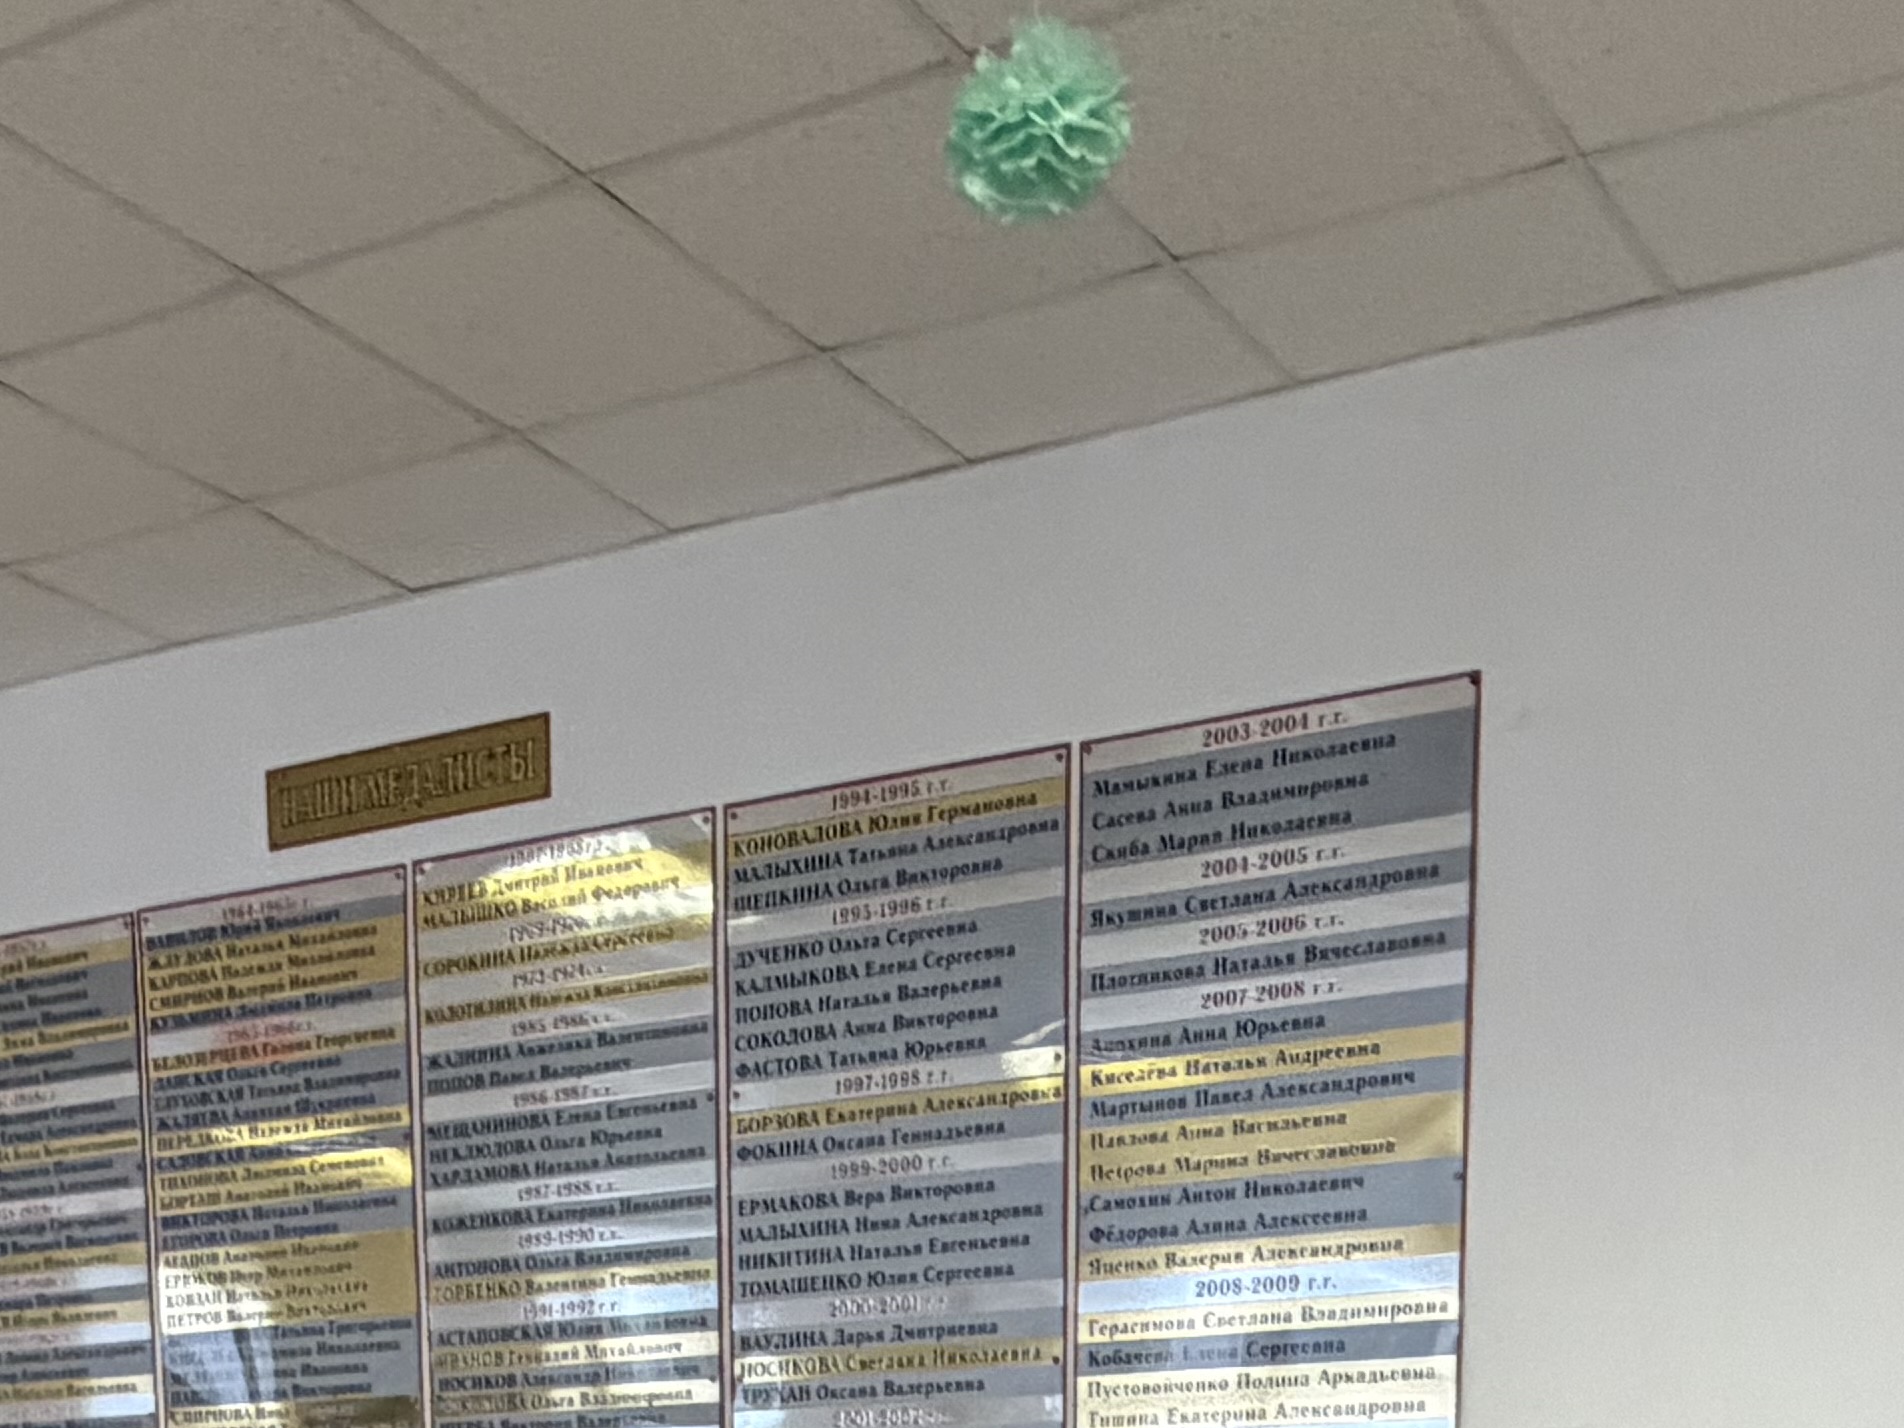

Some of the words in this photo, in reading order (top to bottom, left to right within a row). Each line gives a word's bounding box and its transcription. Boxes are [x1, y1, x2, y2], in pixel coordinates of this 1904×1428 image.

[366, 738, 536, 810] МЕДАЛИСТЫ
[1092, 768, 1197, 798] Мамыкина
[1207, 757, 1263, 779] Елена
[1272, 733, 1396, 768] Николаевна
[1164, 799, 1212, 819] Анна
[1221, 773, 1368, 810] Владимировна
[734, 818, 862, 856] КОНОВАЛОВА
[868, 813, 921, 834] Юлия
[927, 794, 1036, 824] Германовна
[1091, 839, 1149, 863] Скиба
[1159, 830, 1222, 853] Мария
[1230, 810, 1351, 842] Николаевна
[734, 851, 843, 884] МАЛЫХИНА
[848, 843, 918, 866] Татьяна
[923, 820, 1059, 854] Александровна
[1200, 846, 1307, 878] 2004-2005
[837, 876, 889, 896] Ольга
[895, 859, 1003, 887] Викторовна
[1090, 903, 1177, 928] Якушина
[1184, 889, 1275, 914] Светлана
[1284, 865, 1438, 900] Александровна
[829, 935, 880, 954] Ольга
[886, 921, 976, 946] Сергеевна
[1199, 914, 1306, 945] 2005-2006
[735, 963, 859, 995] КАЛМЫКОВА
[865, 959, 917, 978] Елена
[922, 945, 1015, 970] Сергеевна
[1090, 965, 1204, 992] Плотникова
[1212, 953, 1294, 975] Наталья
[1304, 932, 1446, 963] Вячеславовна
[735, 997, 811, 1023] ПОПОВА
[818, 991, 890, 1012] Наталья
[897, 977, 1001, 1002] Валерьевна
[1201, 980, 1304, 1010] 2007-2008
[735, 1022, 836, 1051] СОКОЛОВА
[842, 1020, 885, 1038] Анна
[893, 1006, 998, 1032] Викторовна
[1178, 1026, 1226, 1045] Анна
[1235, 1015, 1325, 1040] Юрьевна
[736, 1052, 822, 1079] ФАСТОВА
[830, 1048, 897, 1068] Татьяна
[905, 1037, 985, 1061] Юрьевна
[1185, 1055, 1266, 1076] Наталья
[1275, 1042, 1380, 1066] Андреевна
[736, 1109, 818, 1134] БОРЗОВА
[826, 1103, 916, 1124] Екатерина
[923, 1087, 1060, 1114] Александровна
[1089, 1097, 1186, 1119] Мартынов
[1195, 1090, 1253, 1107] Павел
[1261, 1072, 1415, 1100] Александрович
[736, 1137, 817, 1161] ФОКИНА
[822, 1134, 884, 1152] Оксана
[892, 1122, 1004, 1145] Геннадьевна
[1091, 1131, 1169, 1150] Павлова
[1176, 1124, 1223, 1142] Анна
[1232, 1113, 1346, 1136] Васильевна
[1089, 1163, 1165, 1182] Петрова
[1175, 1156, 1248, 1174] Марина
[1257, 1141, 1396, 1166] Вячеславовна
[738, 1191, 838, 1215] ЕРМАКОВА
[845, 1189, 884, 1207] Вера
[890, 1180, 994, 1201] Викторовна
[1089, 1194, 1171, 1212] Самохин
[1180, 1187, 1236, 1204] Антон
[1244, 1176, 1364, 1198] Николаевич
[906, 1205, 1043, 1228] Александровна
[1089, 1225, 1178, 1243] Фёдорова
[1186, 1219, 1246, 1235] Алина
[1254, 1209, 1367, 1230] Алексеевна
[738, 1246, 844, 1270] НИКИТИНА
[850, 1244, 921, 1261] Наталья
[929, 1235, 1028, 1254] Евгеньевна
[1088, 1258, 1157, 1274] Яценко
[1164, 1251, 1243, 1268] Валерия
[1252, 1239, 1403, 1262] Александровна
[739, 1272, 861, 1297] ТОМАШЕНКО
[867, 1270, 917, 1287] Юлия
[923, 1265, 1014, 1285] Сергеевна
[1195, 1274, 1299, 1298] 2008-2009
[1308, 1277, 1337, 1290] г.г.
[740, 1329, 827, 1351] ВАУЛИНА
[832, 1328, 884, 1347] Дарья
[890, 1322, 998, 1343] Дмитриевна
[1088, 1317, 1195, 1338] Герасимова
[1203, 1311, 1292, 1328] Светлана
[1301, 1301, 1448, 1322] Владимировна
[846, 1354, 924, 1371] Светлана
[932, 1348, 1040, 1366] Николаевна
[1246, 1341, 1345, 1361] Сергеевна
[816, 1384, 877, 1400] Оксана
[883, 1379, 985, 1398] Валерьевна
[1087, 1377, 1228, 1400] Пустовойченко
[1236, 1373, 1309, 1389] Полина
[1318, 1367, 1435, 1388] Аркадьевна
[1089, 1411, 1158, 1428] Тишина
[1167, 1407, 1266, 1425] Екатерина
[1275, 1400, 1426, 1419] Александровна
